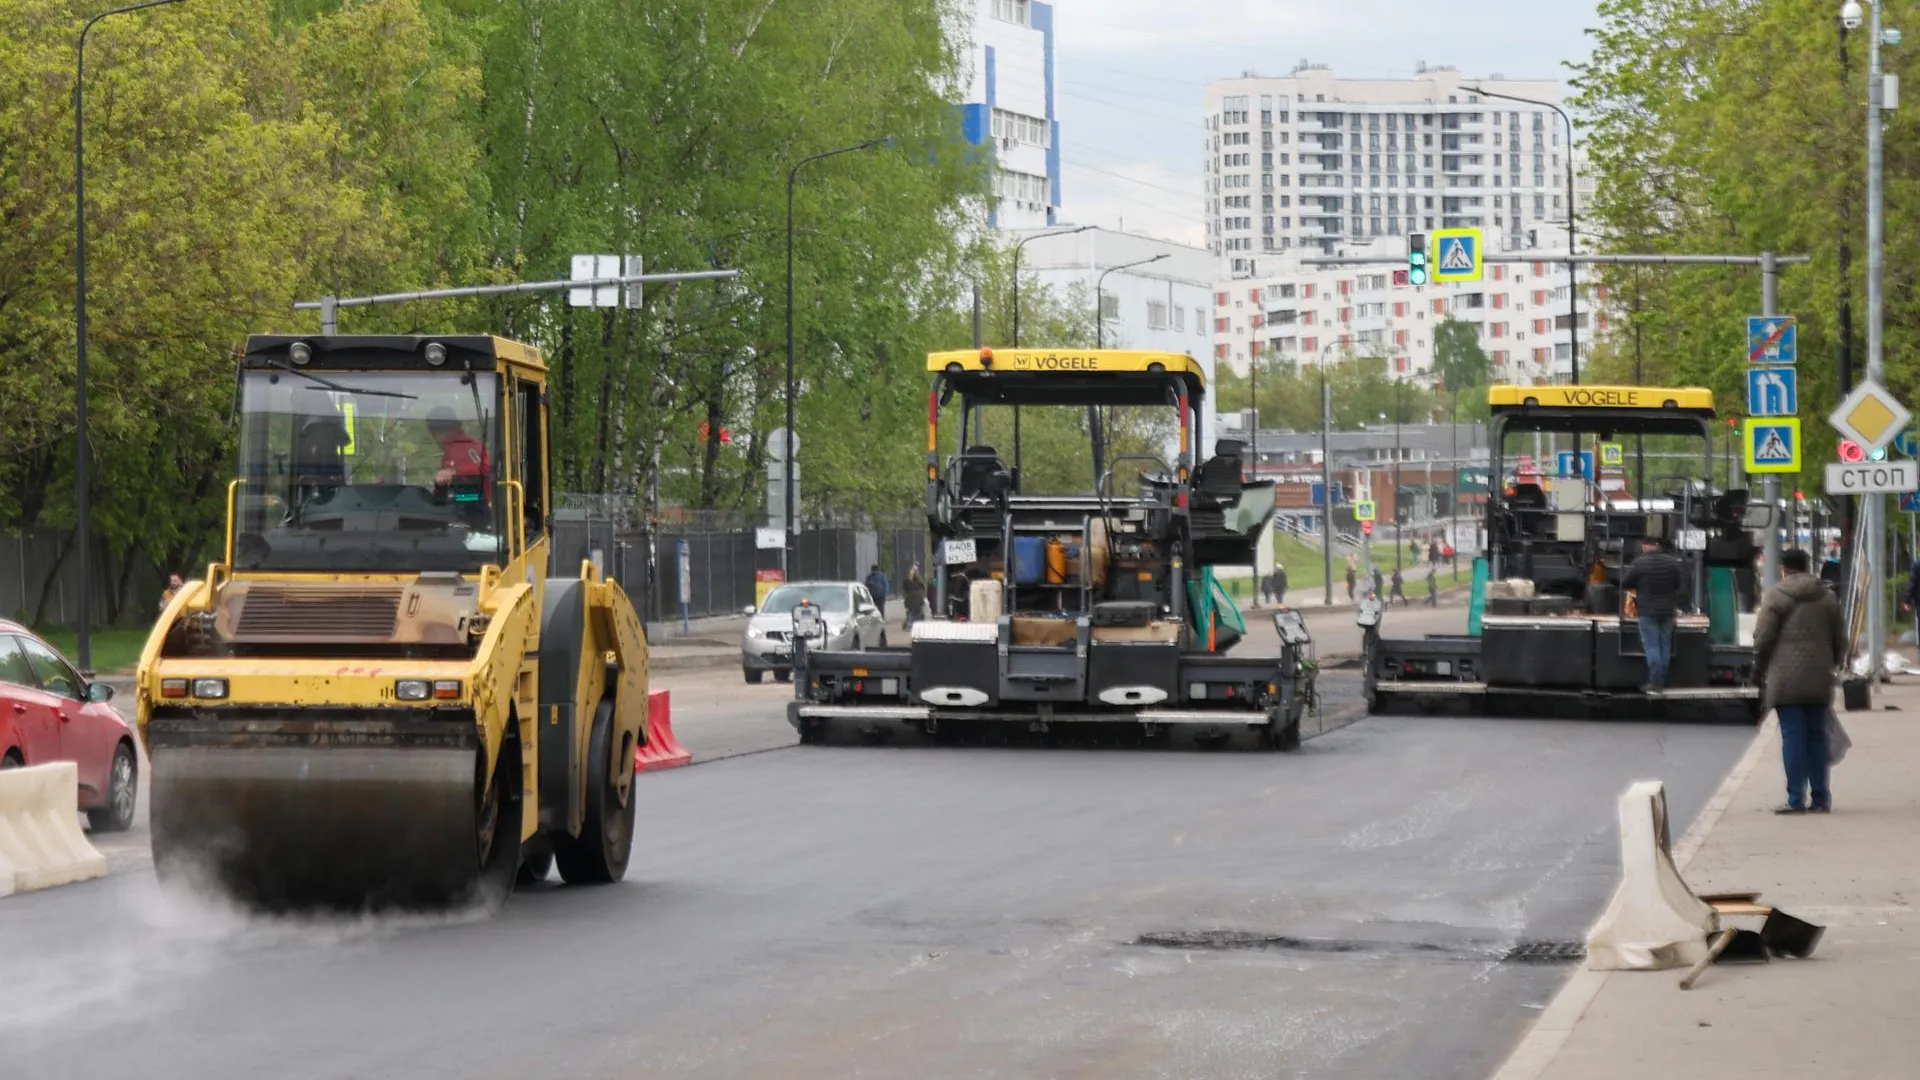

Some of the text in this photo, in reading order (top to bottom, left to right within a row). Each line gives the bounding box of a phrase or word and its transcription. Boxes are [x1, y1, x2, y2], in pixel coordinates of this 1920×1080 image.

[1035, 354, 1098, 369] VÖGELE
[1563, 389, 1638, 405] VÖGELE
[1842, 468, 1905, 488] СТОП
